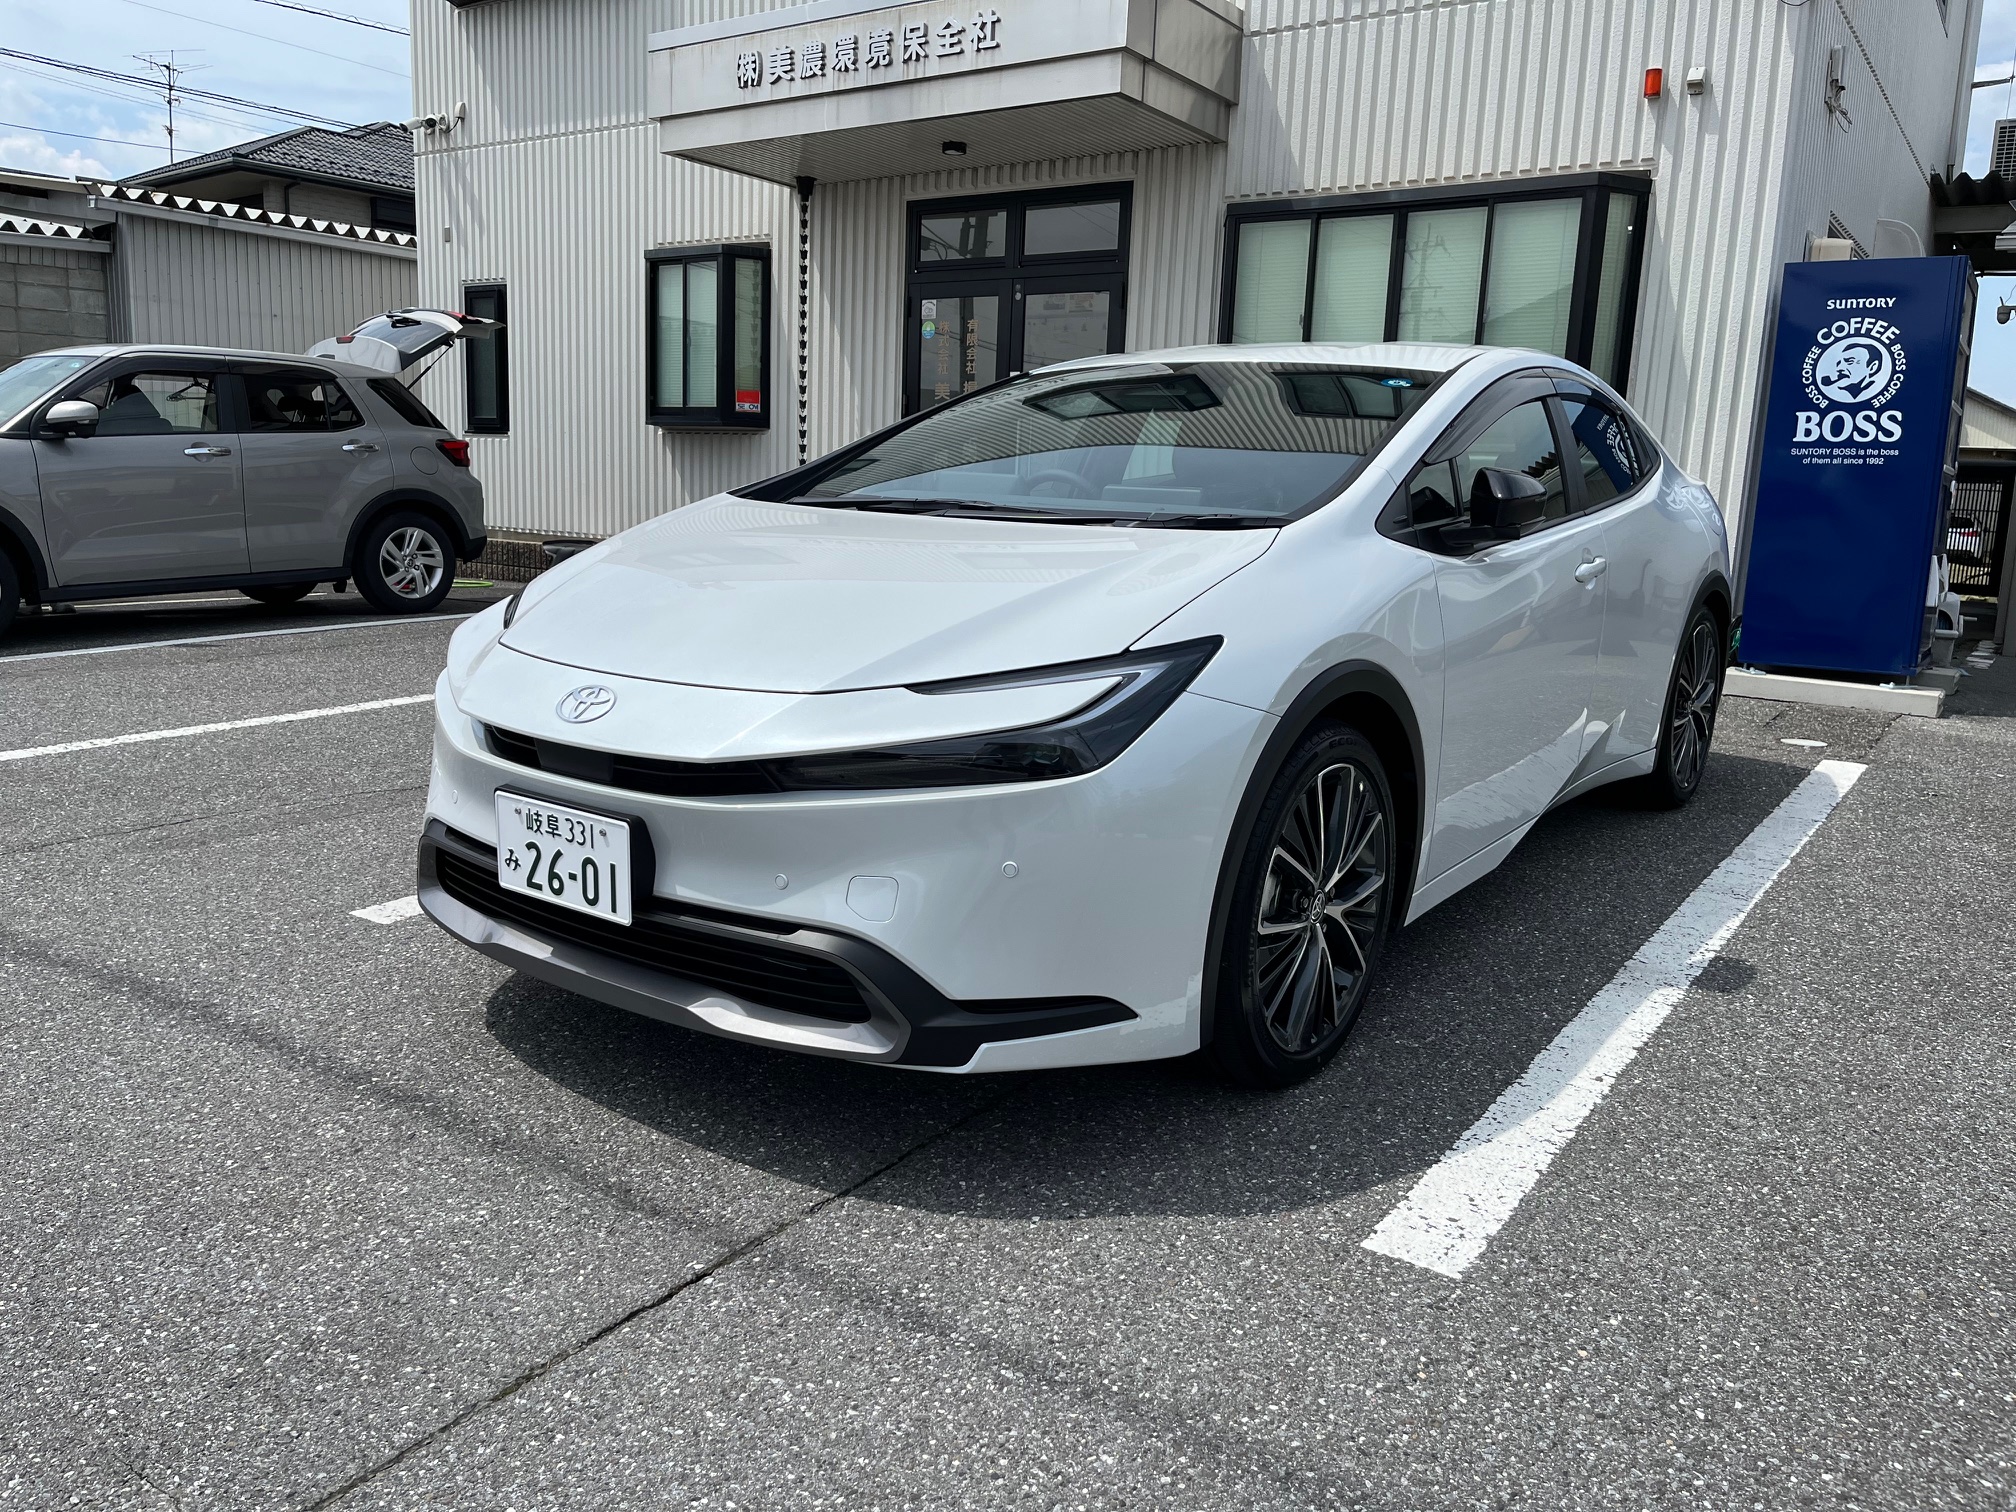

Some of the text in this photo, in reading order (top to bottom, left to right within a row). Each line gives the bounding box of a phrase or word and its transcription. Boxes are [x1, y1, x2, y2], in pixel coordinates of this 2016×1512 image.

[1817, 317, 1900, 344] COFFEE
[1827, 297, 1896, 309] SUNTORY
[938, 320, 950, 375] 株式会社
[966, 319, 979, 375] 有限会社
[1802, 345, 1829, 408] BOSS COFFEE
[1871, 343, 1906, 408] BOSS COFFEE
[1793, 410, 1902, 442] BOSS
[525, 807, 594, 849] 岐阜 331
[504, 840, 617, 913] み 26-01
